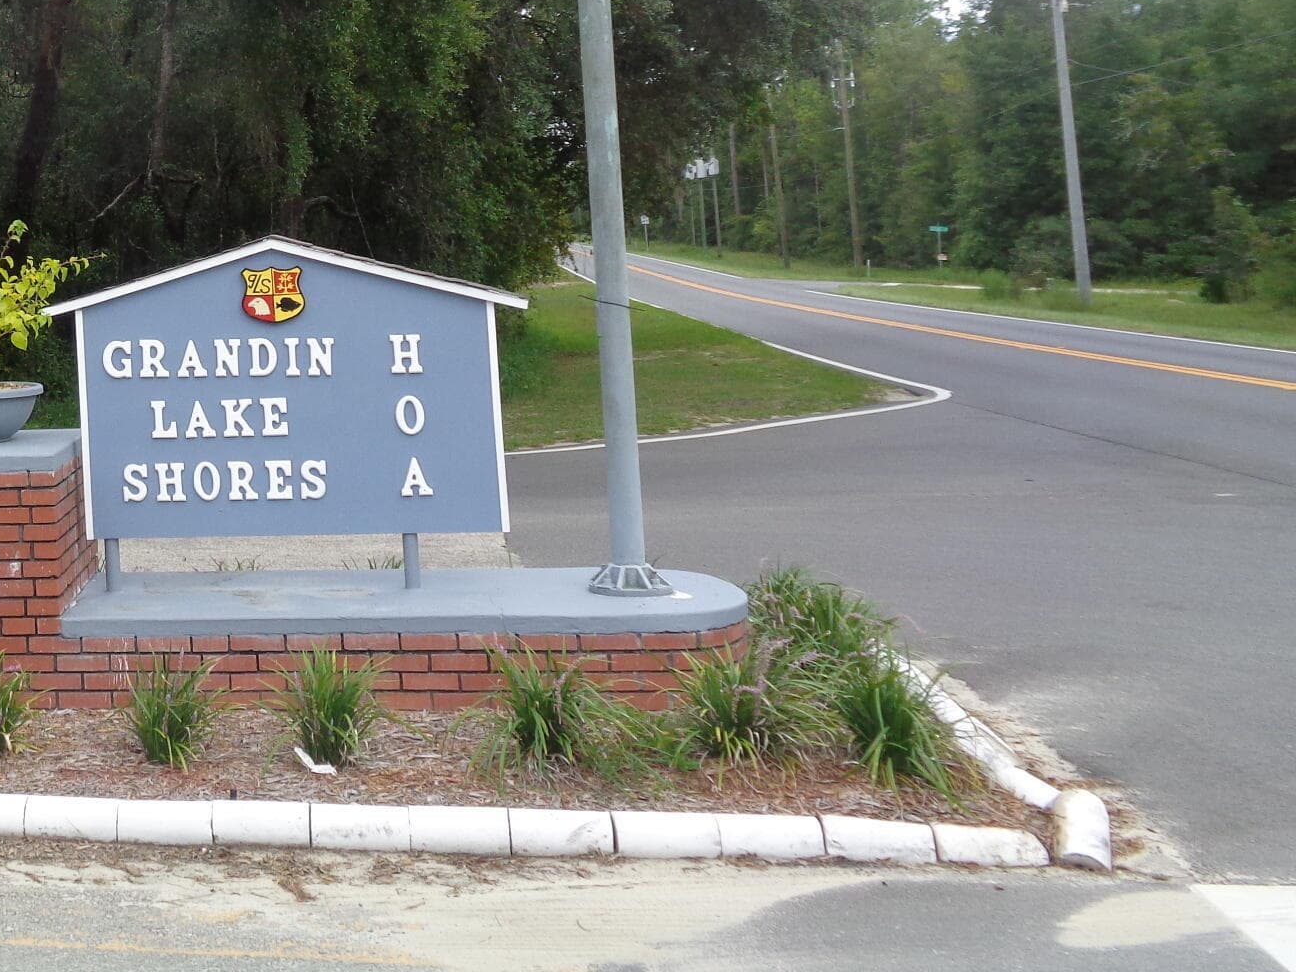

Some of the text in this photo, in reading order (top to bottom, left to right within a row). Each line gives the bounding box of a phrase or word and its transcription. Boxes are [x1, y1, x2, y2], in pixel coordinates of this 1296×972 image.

[102, 336, 335, 379] GRANDIN
[150, 396, 289, 439] LAKE
[123, 459, 328, 503] SHORES
